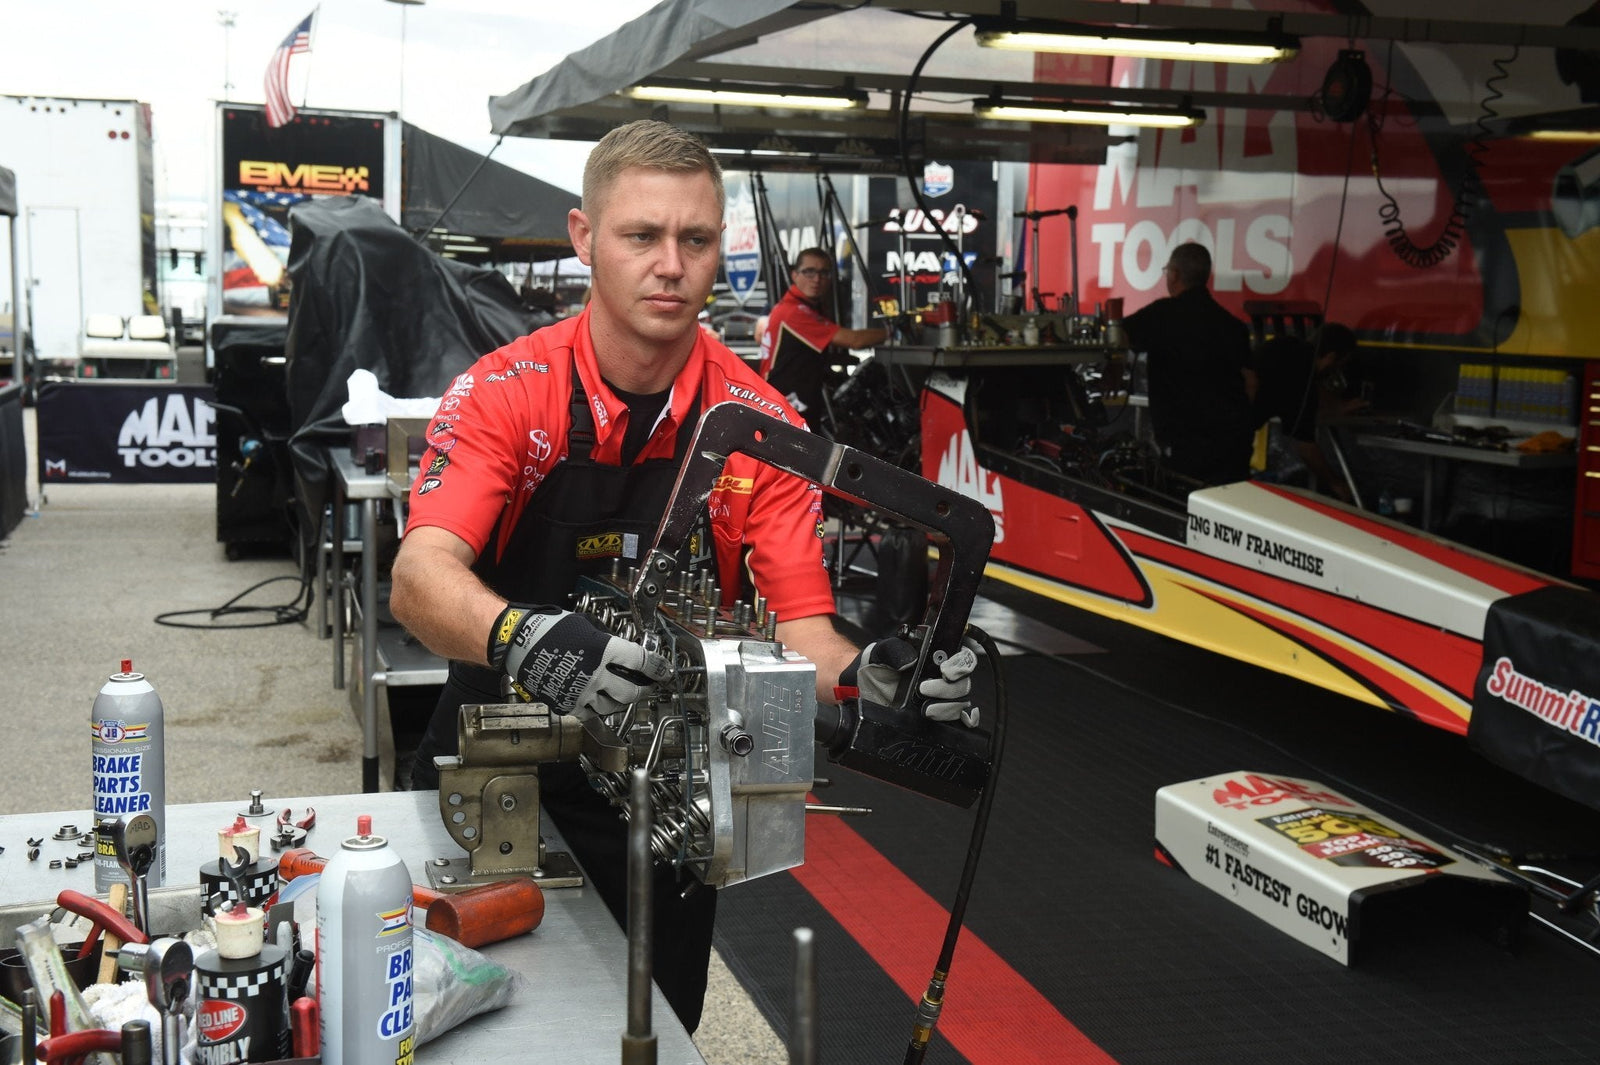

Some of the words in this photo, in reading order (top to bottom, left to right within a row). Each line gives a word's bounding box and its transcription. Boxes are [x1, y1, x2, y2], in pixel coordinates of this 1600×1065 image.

[1092, 214, 1293, 294] TOOLS
[937, 428, 1004, 512] MAC
[1214, 522, 1244, 547] NEW
[1246, 533, 1324, 577] FRANCHISE
[524, 648, 554, 697] Mechanix
[541, 650, 580, 701] Mechanix
[1486, 656, 1600, 748] SummitR
[93, 754, 141, 773] BRAKE
[93, 776, 140, 794] PARTS
[98, 843, 117, 856] BRA
[1206, 843, 1221, 869] #1
[1225, 853, 1291, 907] FASTEST
[1296, 893, 1349, 940] GROW
[389, 949, 412, 979] BR
[391, 976, 412, 1006] PA
[213, 1006, 239, 1026] LINE
[380, 1004, 412, 1036] CLE
